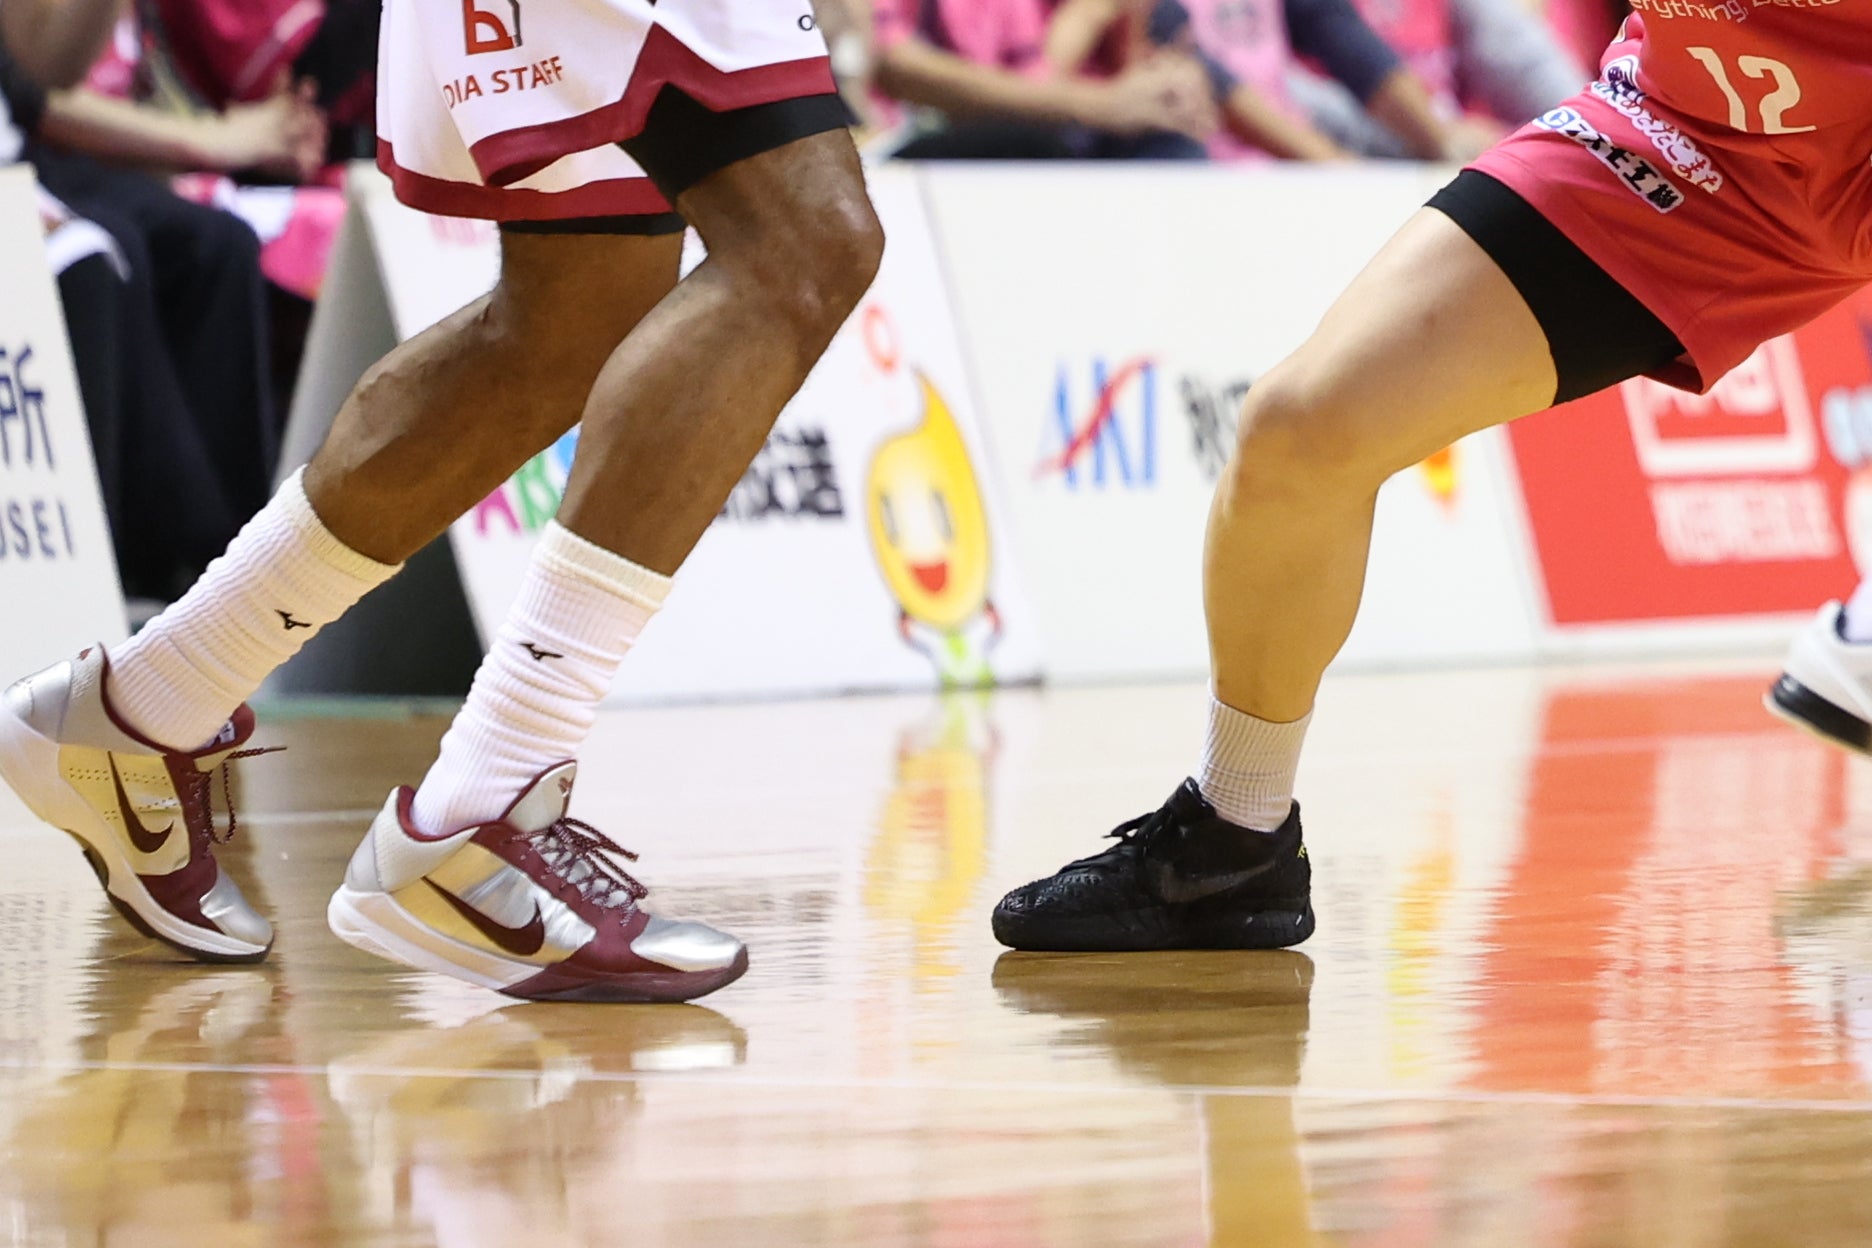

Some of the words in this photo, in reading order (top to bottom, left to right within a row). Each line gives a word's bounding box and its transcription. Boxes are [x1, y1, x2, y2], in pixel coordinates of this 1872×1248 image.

[443, 74, 483, 109] DIA
[491, 55, 563, 94] STAFF
[1685, 46, 1817, 135] 12
[0, 499, 76, 560] SEI
